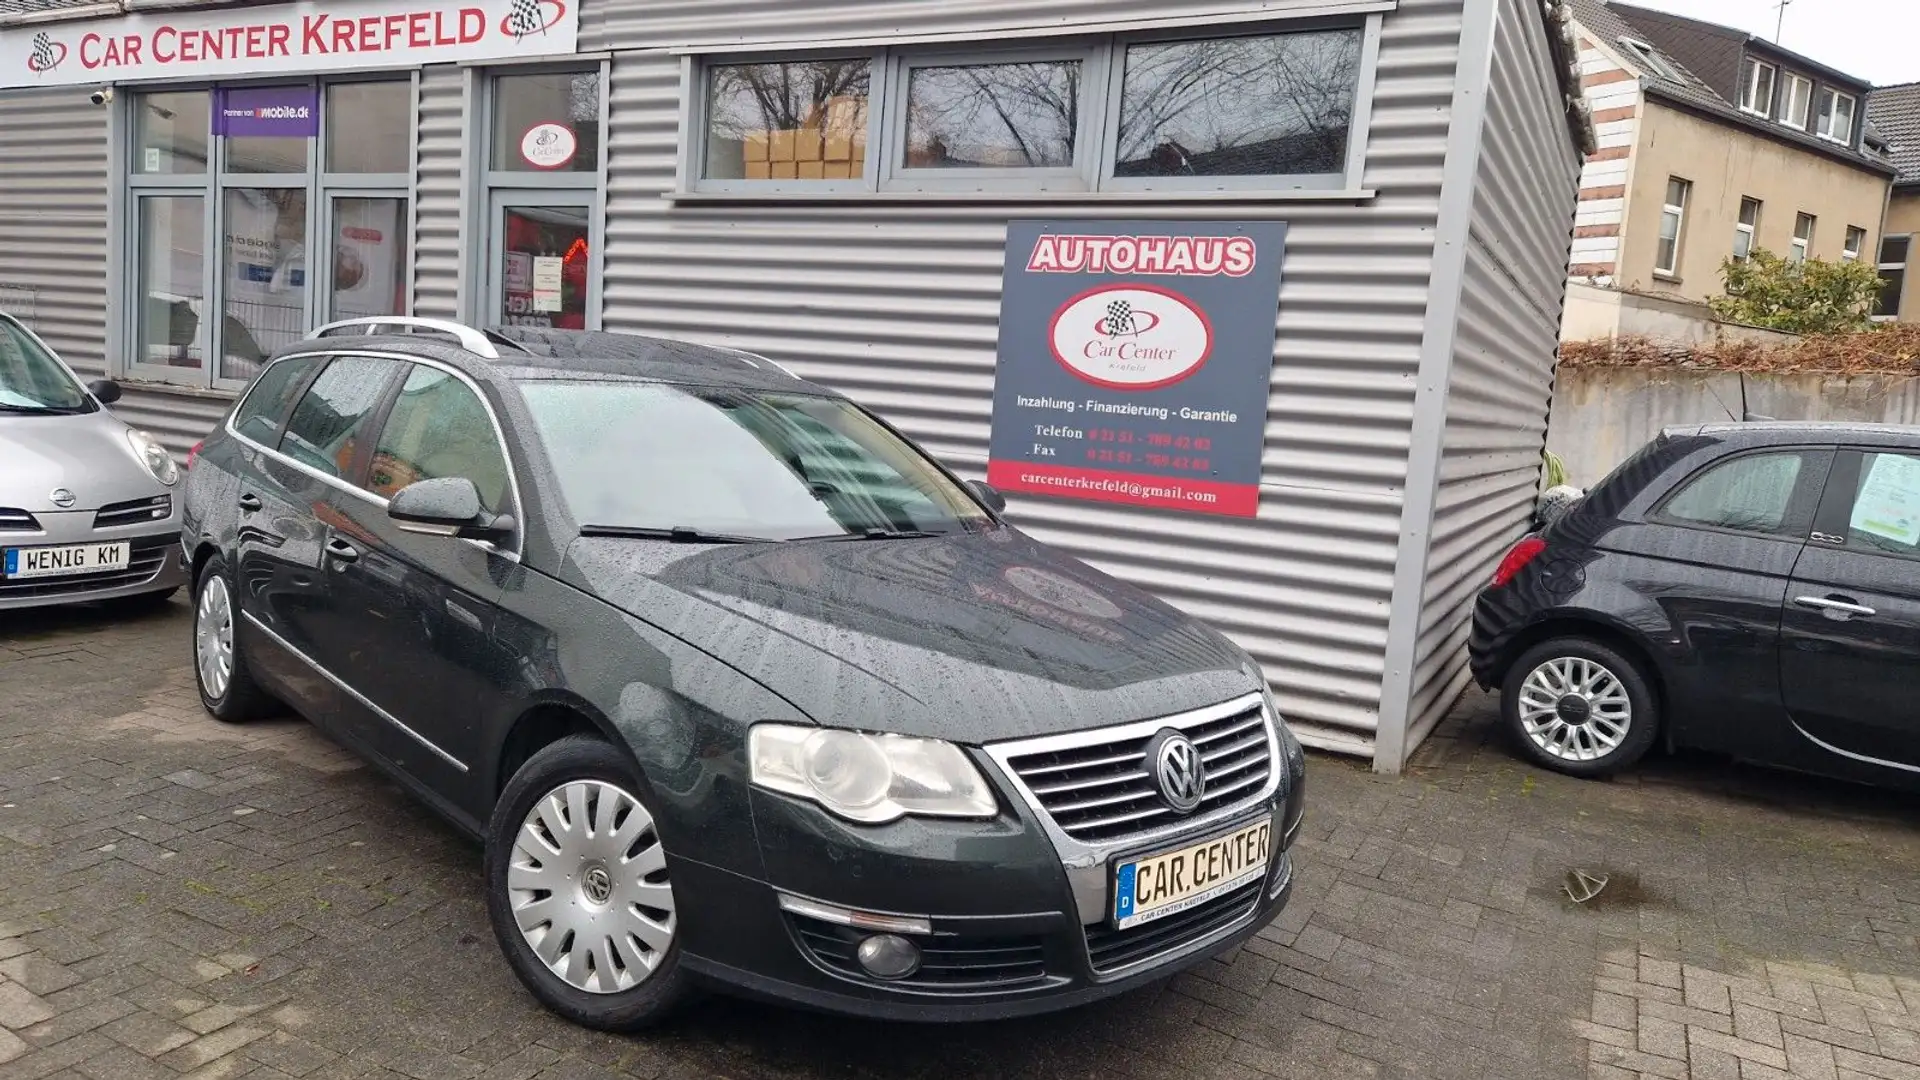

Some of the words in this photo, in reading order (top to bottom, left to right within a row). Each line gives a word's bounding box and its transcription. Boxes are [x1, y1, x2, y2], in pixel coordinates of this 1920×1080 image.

[1025, 234, 1256, 277] AUTOHAUS
[1083, 339, 1115, 359] Car
[1117, 341, 1177, 361] Center
[1017, 395, 1075, 413] Inzahlung
[1086, 400, 1168, 420] Finanzierung
[1180, 406, 1238, 423] Garantie
[1034, 424, 1083, 439] Telefon
[1033, 443, 1056, 456] Fax
[1021, 473, 1217, 503] carcenterkrefeld@gmail.com
[27, 548, 85, 570] WENIG
[98, 546, 119, 564] KM
[1121, 896, 1129, 908] D
[1136, 824, 1269, 906] CAR.CENTER
